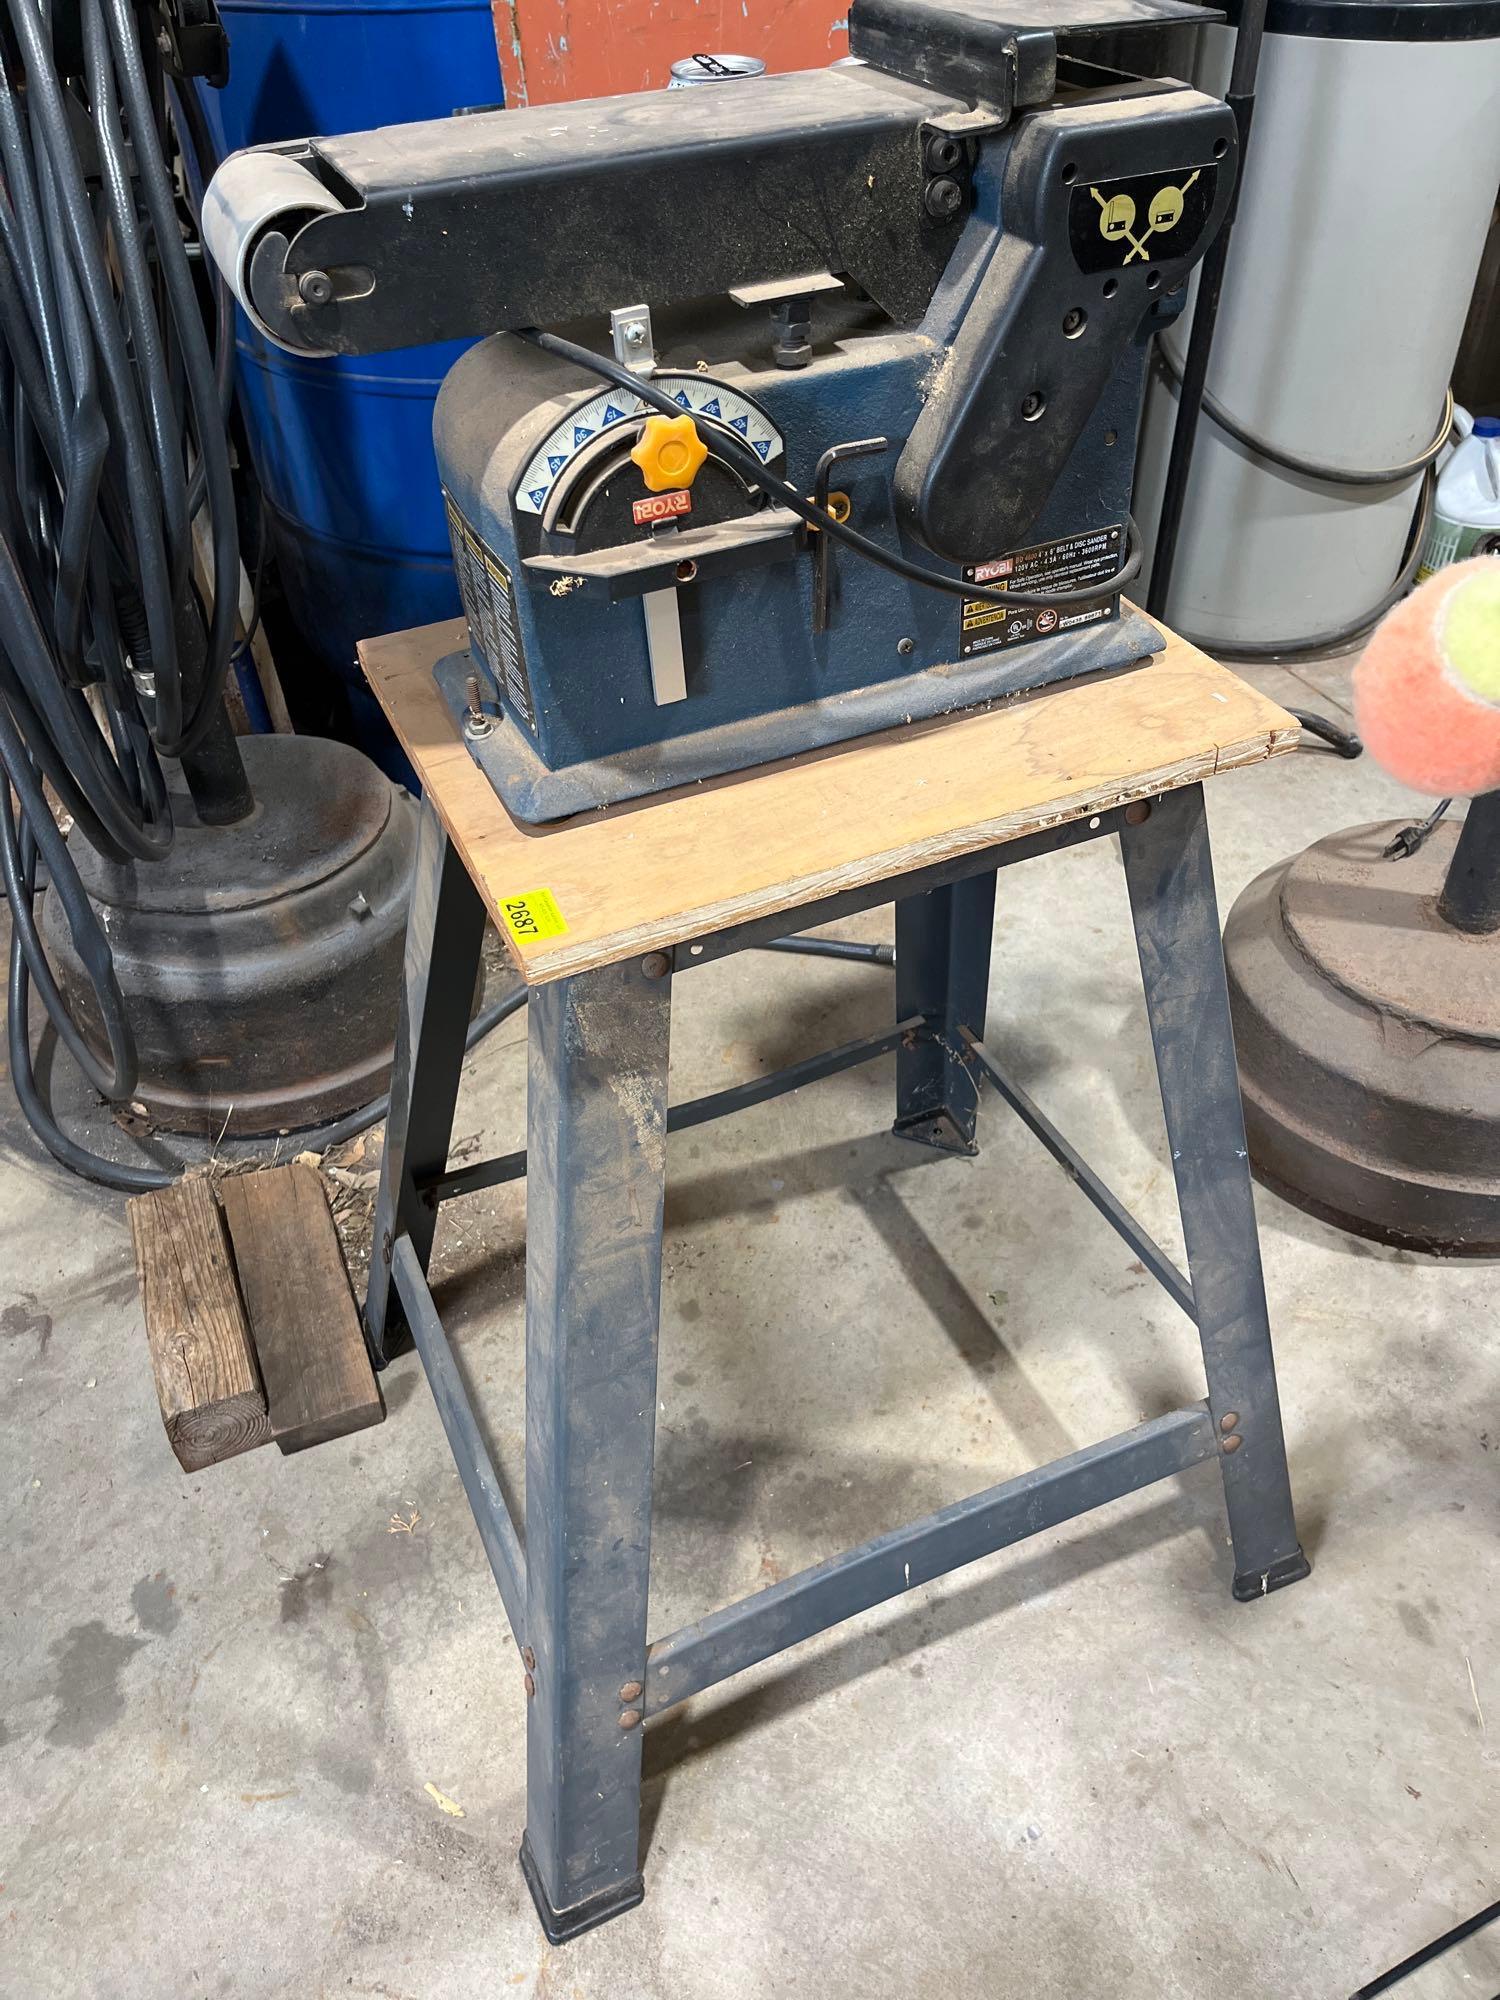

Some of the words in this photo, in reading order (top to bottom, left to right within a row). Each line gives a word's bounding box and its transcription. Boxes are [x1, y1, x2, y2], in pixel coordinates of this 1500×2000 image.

[606, 409, 618, 419] 15
[706, 403, 720, 414] 30
[734, 417, 747, 430] 45
[575, 429, 588, 443] 30
[756, 442, 769, 454] 60
[551, 457, 561, 470] 45
[533, 490, 544, 504] 60
[635, 494, 690, 520] RYOBI
[1056, 543, 1070, 554] BELT
[1074, 539, 1087, 549] DISC
[1086, 534, 1108, 546] SANDER
[1015, 562, 1029, 572] 120V
[1029, 560, 1039, 569] AC
[1081, 542, 1108, 555] 3600RPM
[975, 560, 1011, 580] RYOBI
[973, 611, 1004, 626] ADVERTENCIA
[505, 901, 540, 935] 2687
